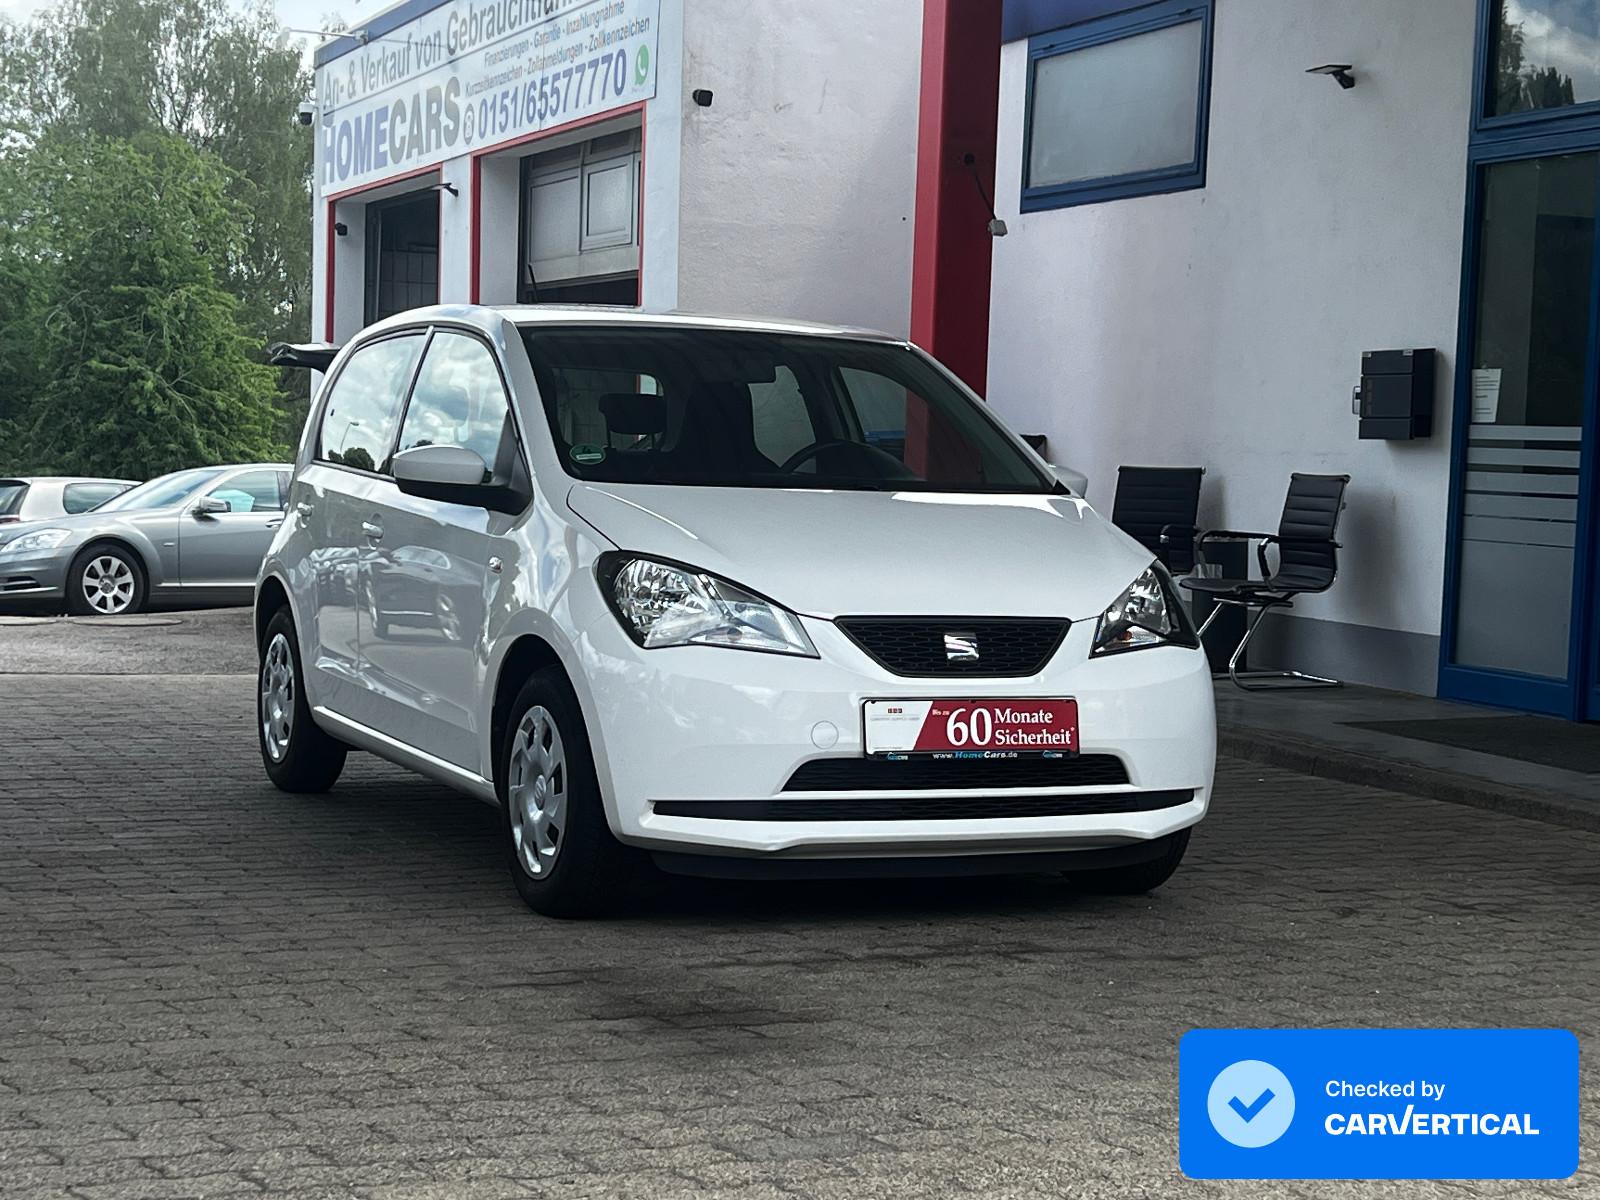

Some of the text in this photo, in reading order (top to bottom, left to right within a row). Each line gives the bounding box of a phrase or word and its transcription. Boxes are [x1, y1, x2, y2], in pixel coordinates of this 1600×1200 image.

[533, 23, 561, 49] Garantie
[588, 16, 650, 52] Zollkennzeichen
[347, 60, 356, 99] &
[361, 32, 412, 93] Verkauf
[415, 30, 441, 70] von
[479, 48, 627, 139] 0151/65577770
[322, 76, 460, 187] HOMECARS
[946, 708, 992, 746] 60
[994, 708, 1053, 724] Monate
